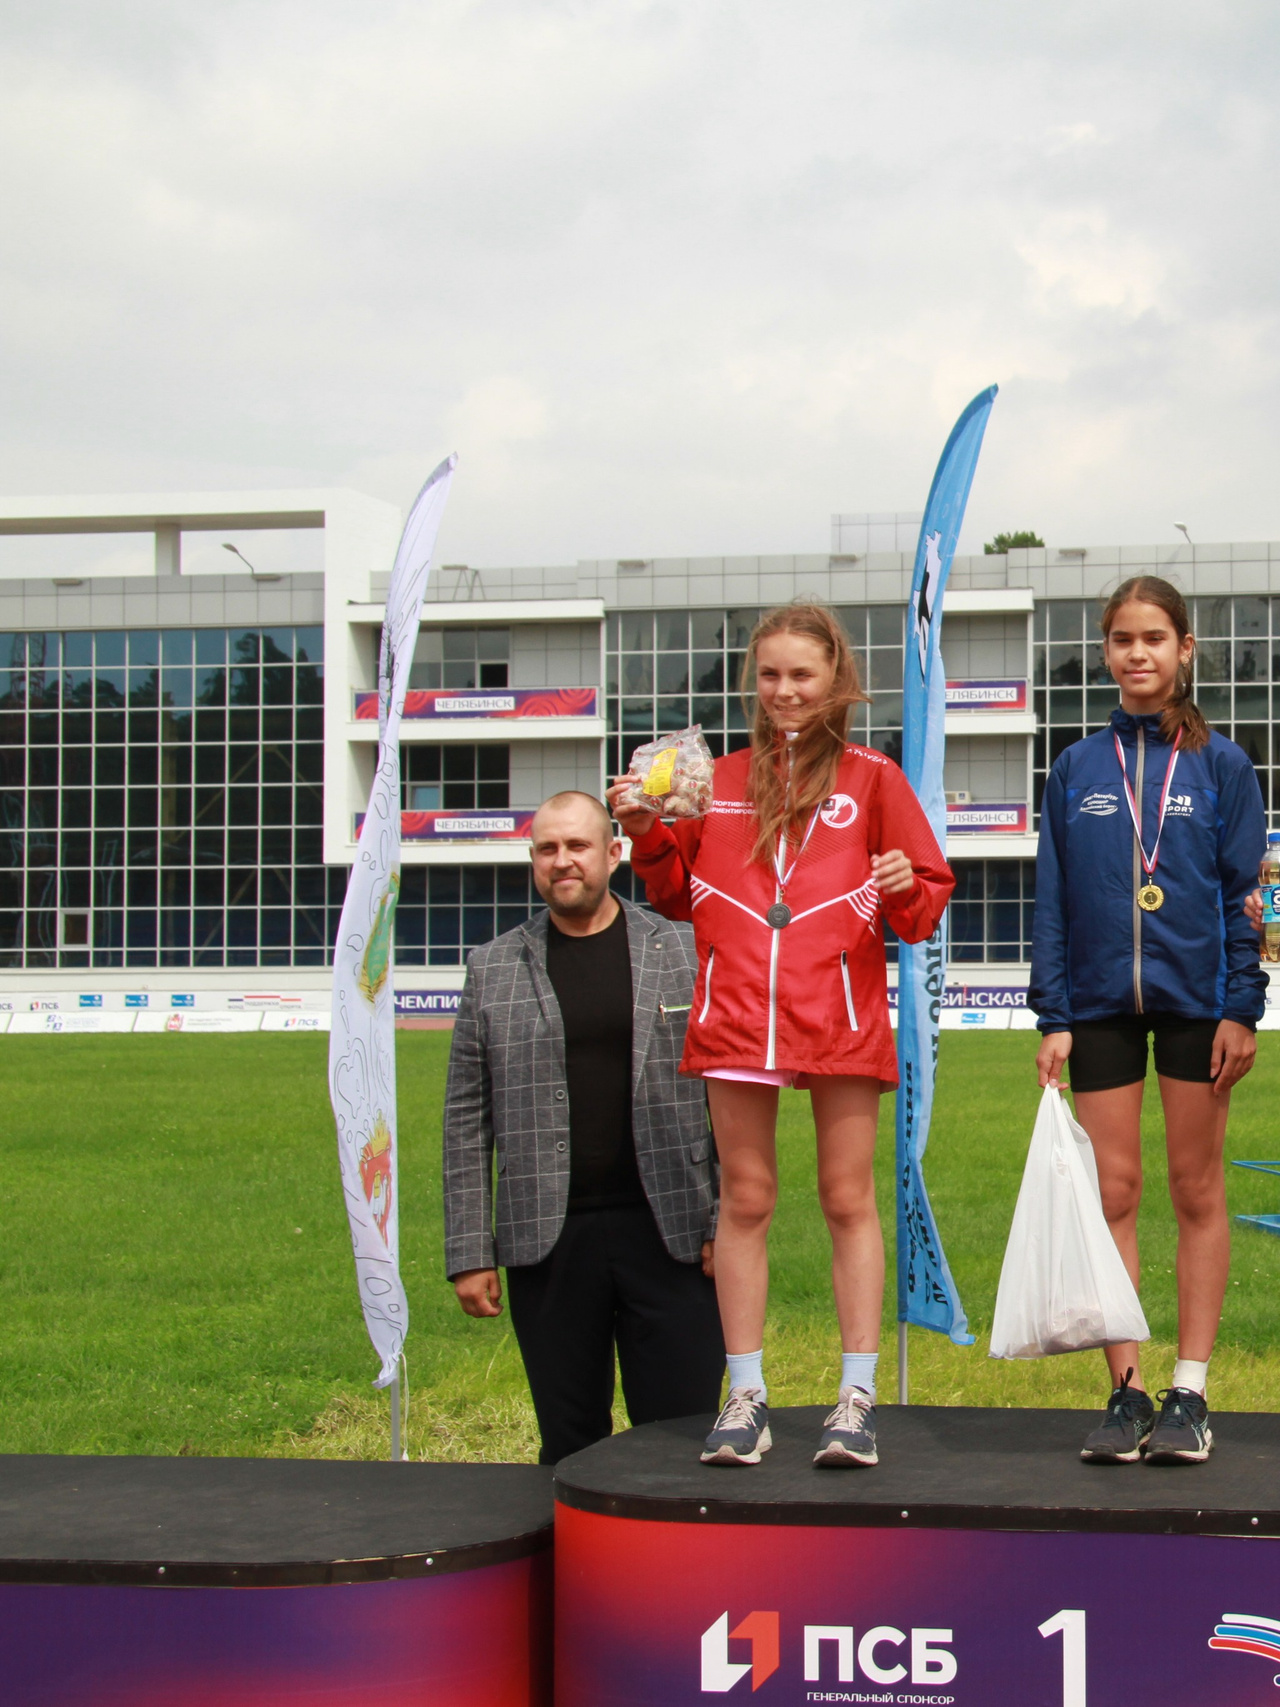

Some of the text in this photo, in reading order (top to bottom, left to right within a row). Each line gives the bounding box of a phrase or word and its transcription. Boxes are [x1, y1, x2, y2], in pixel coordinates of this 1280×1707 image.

[945, 689, 1014, 700] ЕЛЯБИНСК
[436, 699, 512, 710] ЧЕЛЯБИНСК
[712, 800, 754, 808] ПОРТИВНОЕ
[946, 812, 1015, 823] ЕЛЯБИНСК
[436, 819, 512, 831] ЧЕЛЯБИНСК
[41, 1002, 59, 1010] ПСБ
[394, 995, 461, 1009] ЧЕМПИ
[298, 1018, 319, 1026] ПСБ
[803, 1625, 958, 1686] ПСБ
[1037, 1608, 1087, 1707] 1
[806, 1690, 955, 1705] ГЕНЕРАЛЬНЫЙ СПОНСОР
